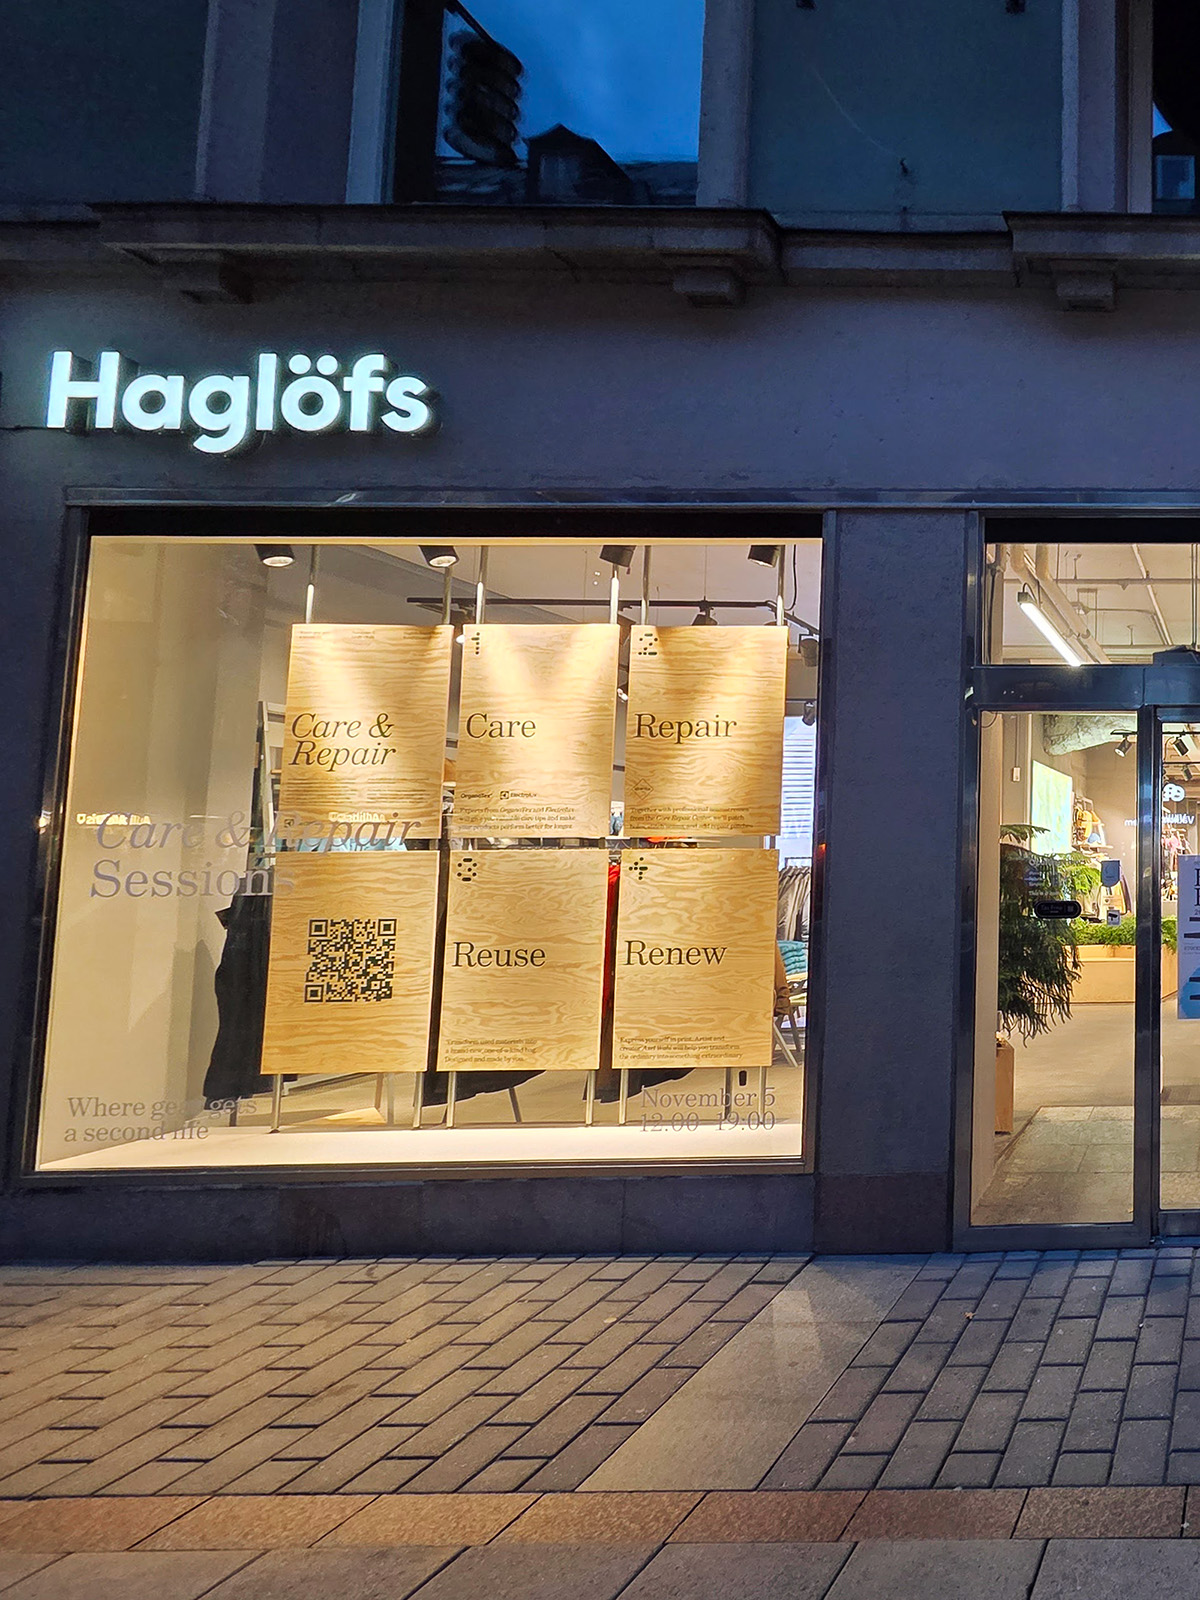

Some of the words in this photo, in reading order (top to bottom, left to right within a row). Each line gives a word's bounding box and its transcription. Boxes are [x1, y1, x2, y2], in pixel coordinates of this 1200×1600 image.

[46, 350, 431, 453] Haglöfs
[291, 713, 361, 738] Care
[368, 713, 395, 738] &
[466, 713, 536, 738] Care
[634, 713, 737, 744] Repair
[288, 740, 396, 772] Repair
[96, 811, 201, 849] Care
[215, 810, 251, 848] &
[265, 811, 421, 856] Repair
[90, 859, 296, 898] Sessions
[451, 941, 546, 967] Reuse
[624, 940, 728, 966] Renew
[67, 1097, 145, 1117] Where
[150, 1099, 203, 1120] ge
[209, 1096, 257, 1120] gets
[641, 1088, 757, 1107] November
[763, 1087, 775, 1106] 5
[64, 1127, 77, 1142] a
[83, 1121, 165, 1142] second
[172, 1120, 210, 1141] life
